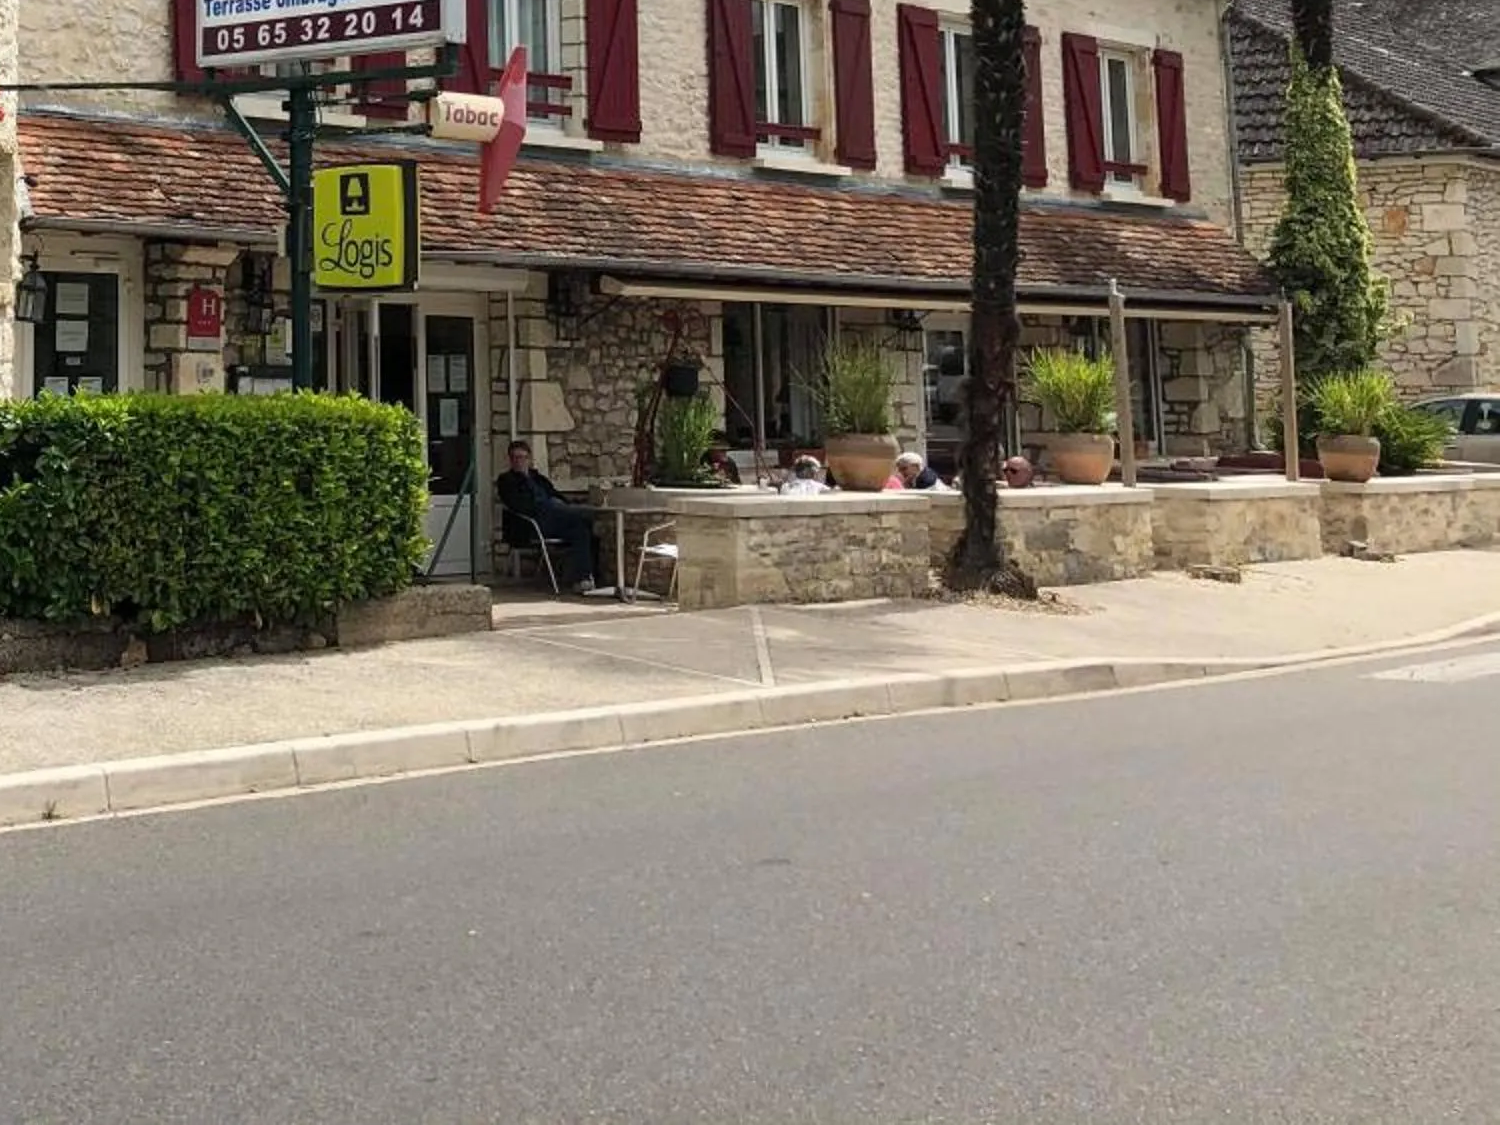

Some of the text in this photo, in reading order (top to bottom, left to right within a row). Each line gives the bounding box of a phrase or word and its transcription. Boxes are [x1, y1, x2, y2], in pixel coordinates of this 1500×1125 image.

[216, 4, 424, 51] 05 65 32 20 14
[444, 102, 500, 126] Tabac
[319, 218, 394, 280] Logis
[202, 297, 217, 317] H
